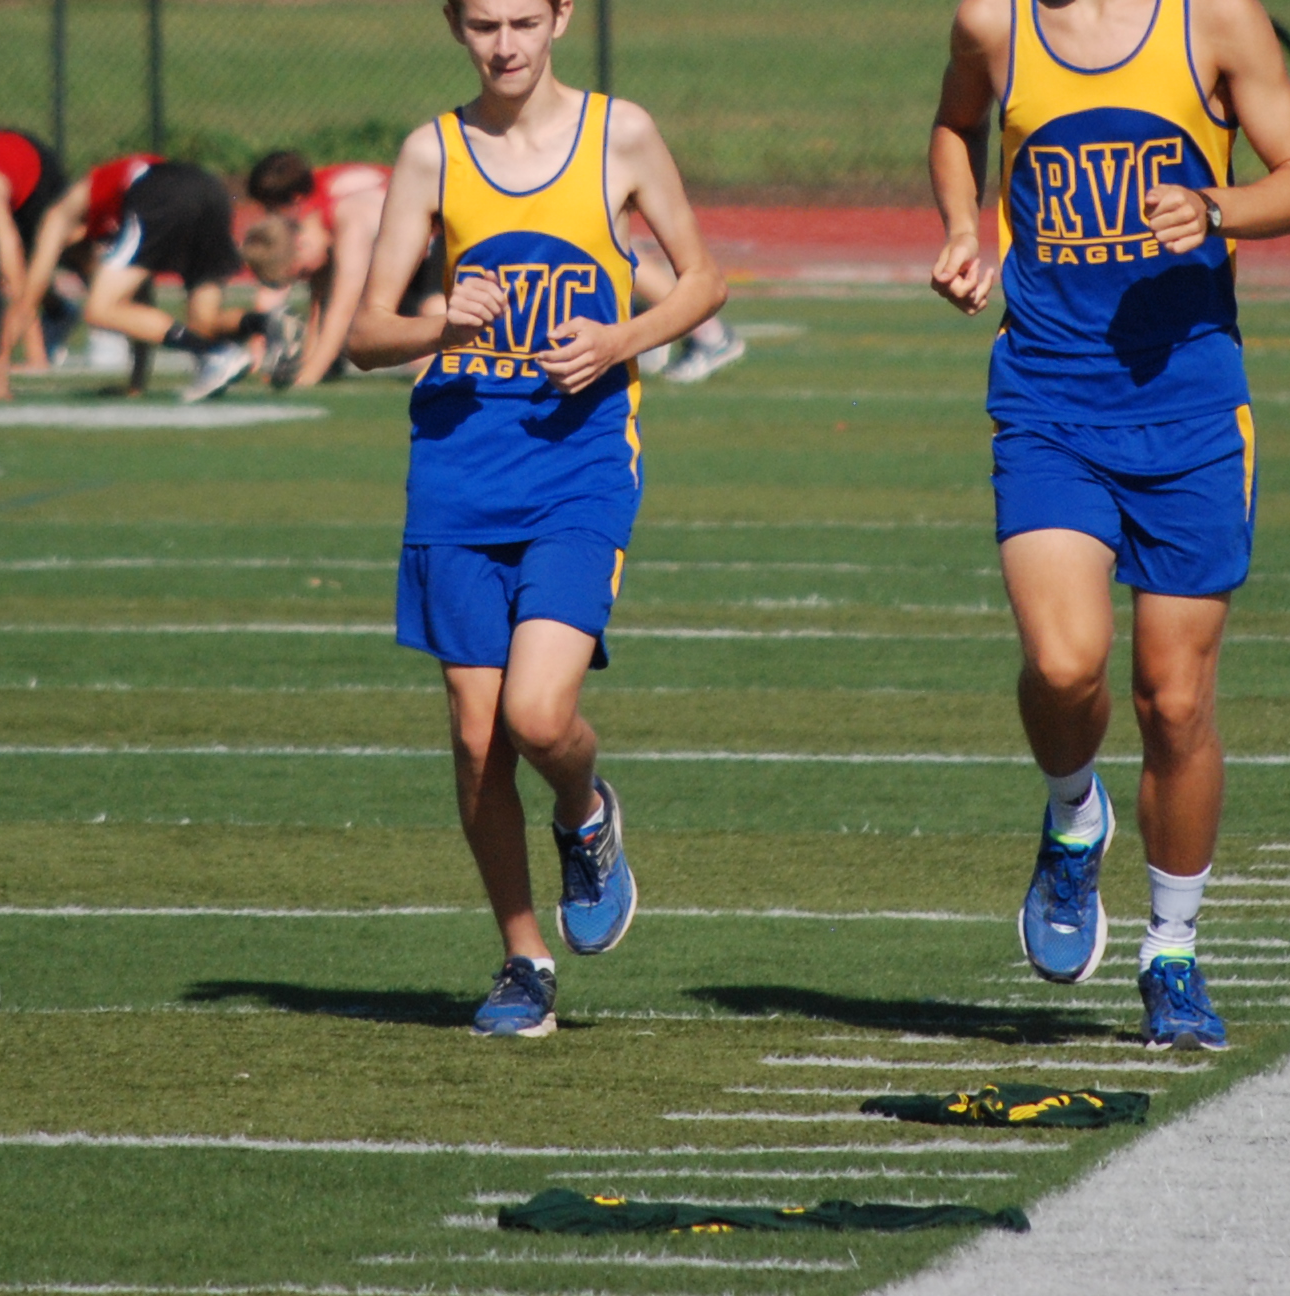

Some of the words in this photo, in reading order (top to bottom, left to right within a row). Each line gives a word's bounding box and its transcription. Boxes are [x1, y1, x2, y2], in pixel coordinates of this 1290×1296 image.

[1028, 136, 1183, 239] RVC
[1036, 239, 1160, 265] EAGLE
[441, 355, 547, 379] EAGL
